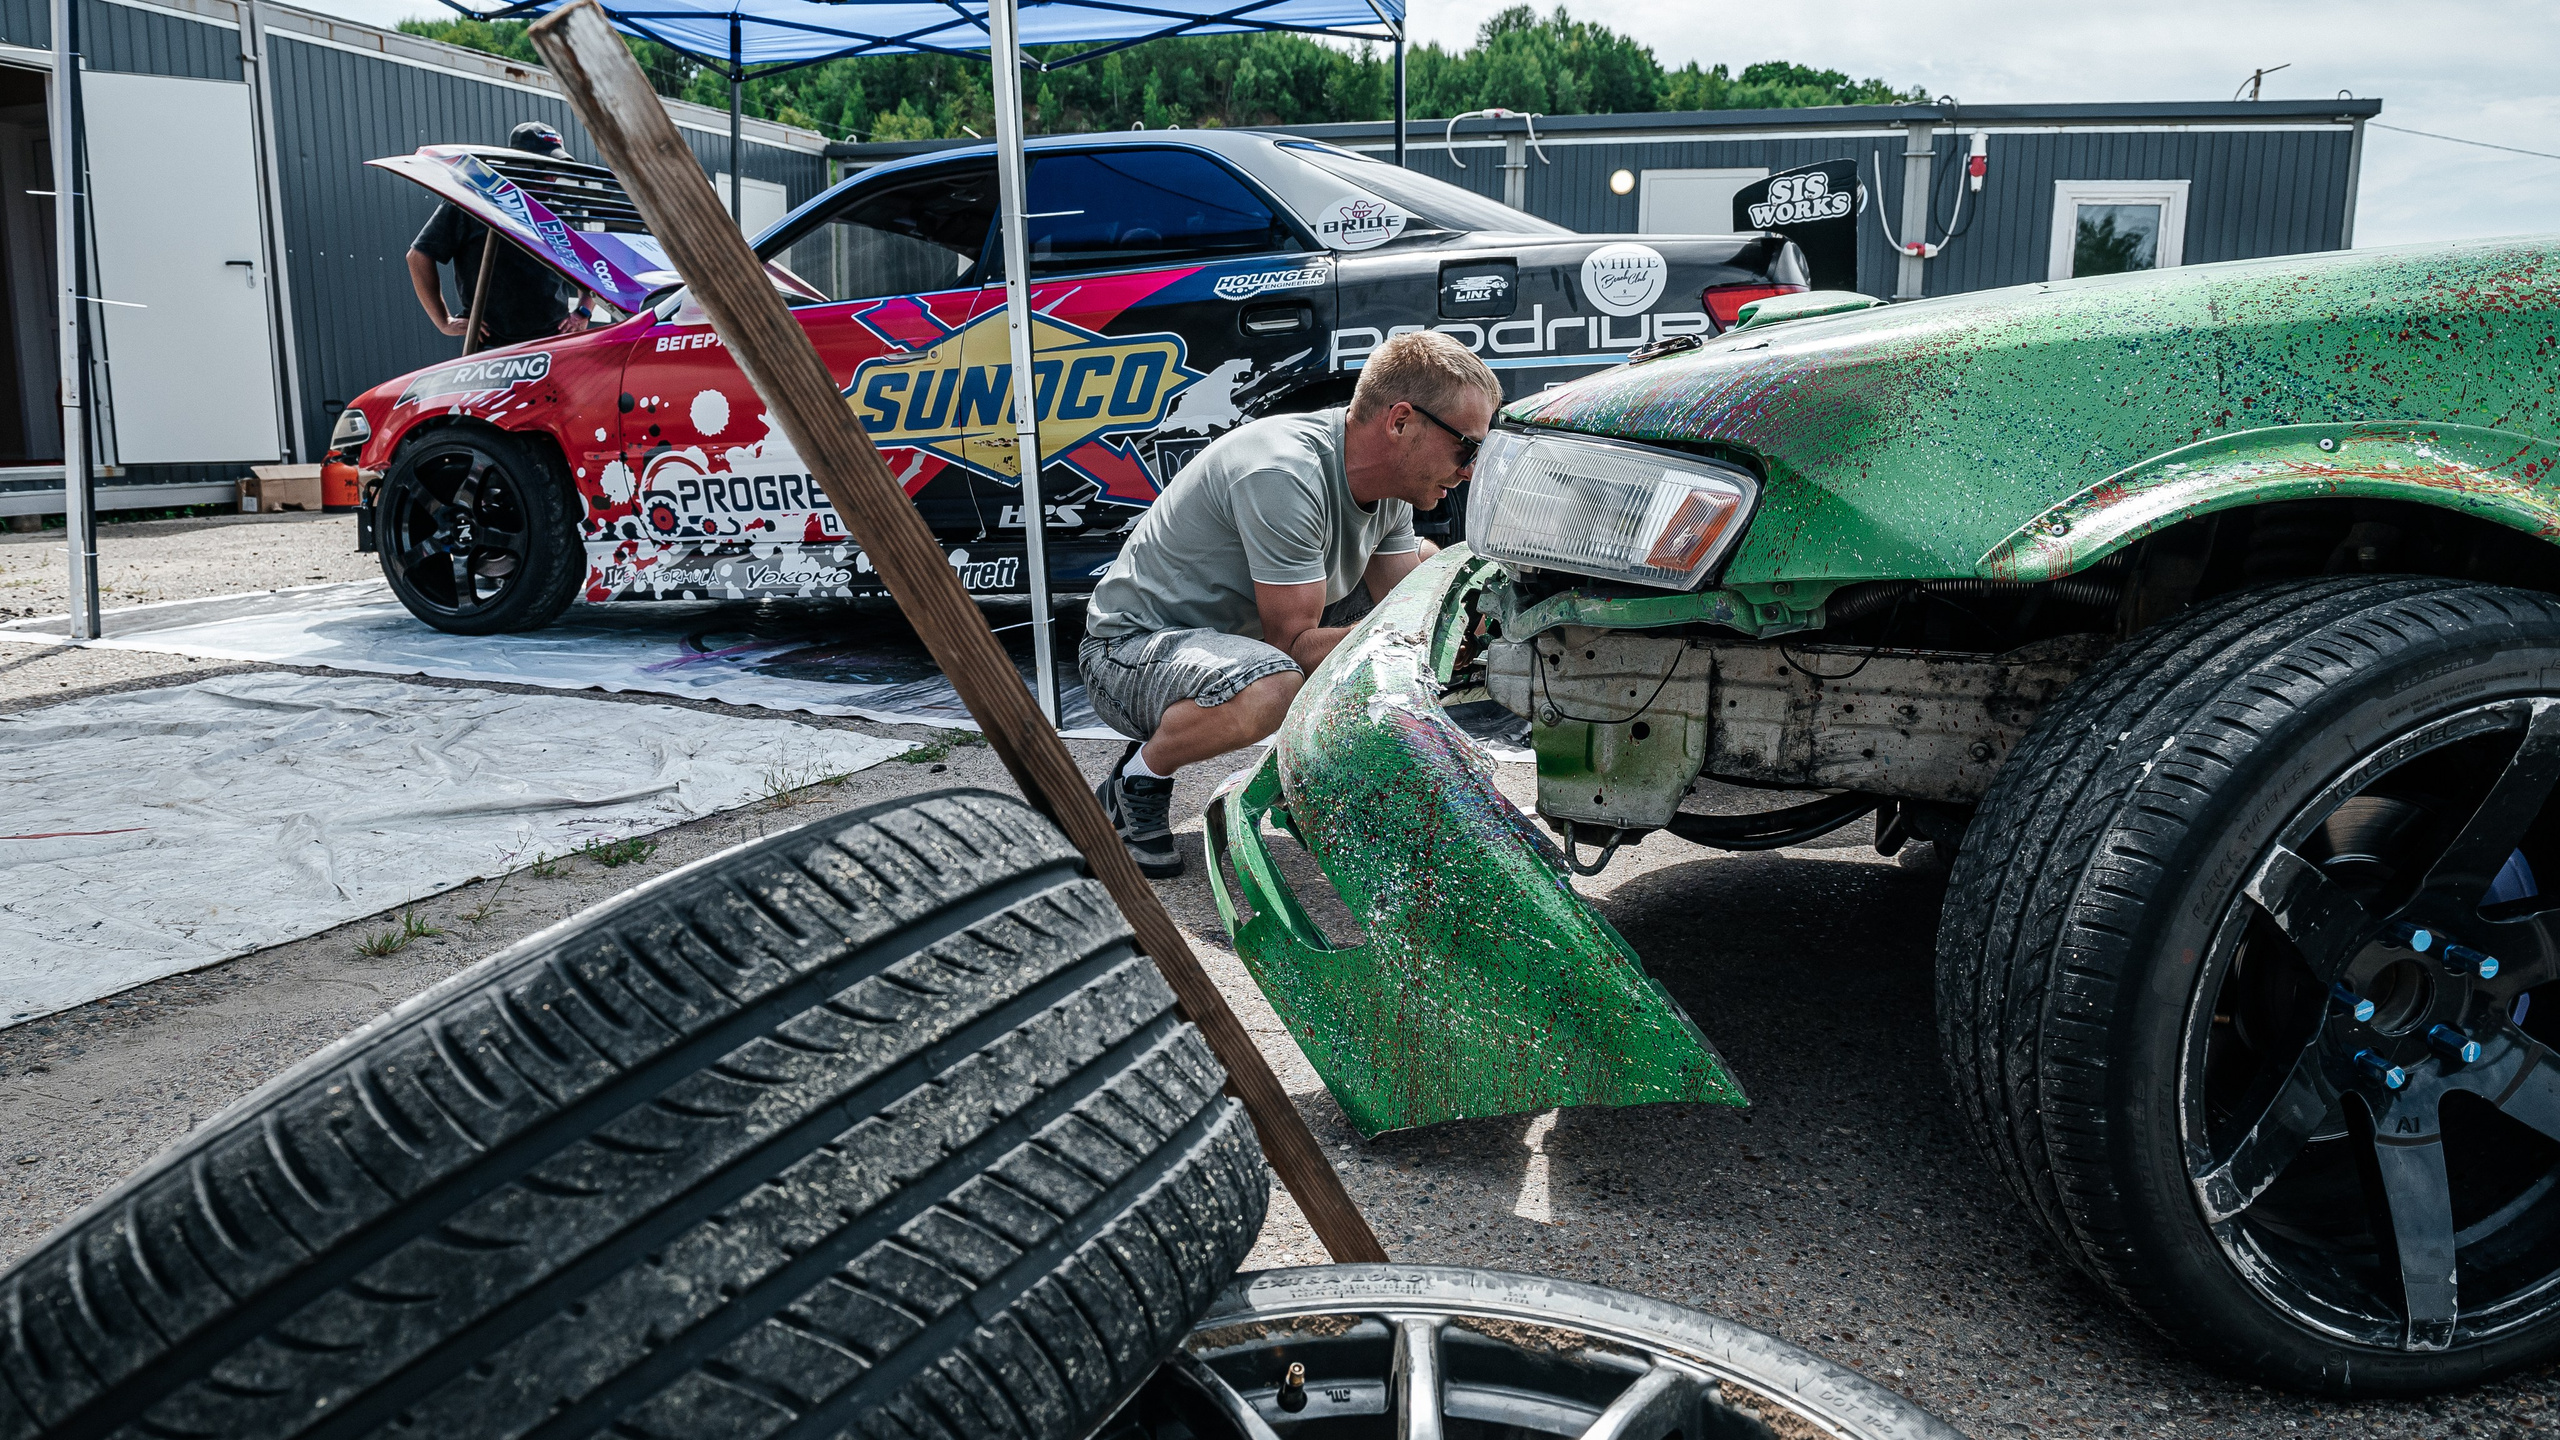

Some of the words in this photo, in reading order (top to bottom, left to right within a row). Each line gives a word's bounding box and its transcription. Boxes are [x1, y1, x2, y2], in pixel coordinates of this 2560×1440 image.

[1769, 173, 1828, 206] SIS
[1749, 193, 1850, 227] WORKS
[1323, 215, 1400, 234] BRIDE
[1591, 257, 1659, 270] WHITE
[1217, 268, 1327, 290] HOLINGER
[1263, 278, 1324, 290] ENGINEERING
[1601, 270, 1629, 289] Beach
[1628, 270, 1649, 285] Club
[1454, 289, 1491, 300] LINK
[452, 356, 546, 384] RACING
[859, 350, 1168, 434] SUNOCO
[1164, 448, 1202, 479] DC
[677, 474, 833, 513] PROGRE
[746, 565, 852, 589] YOKOMO
[950, 557, 1018, 589] rrett
[1252, 1273, 1341, 1291] EXTRA
[1350, 1270, 1426, 1284] LOAD
[1819, 1390, 1860, 1412] DOT
